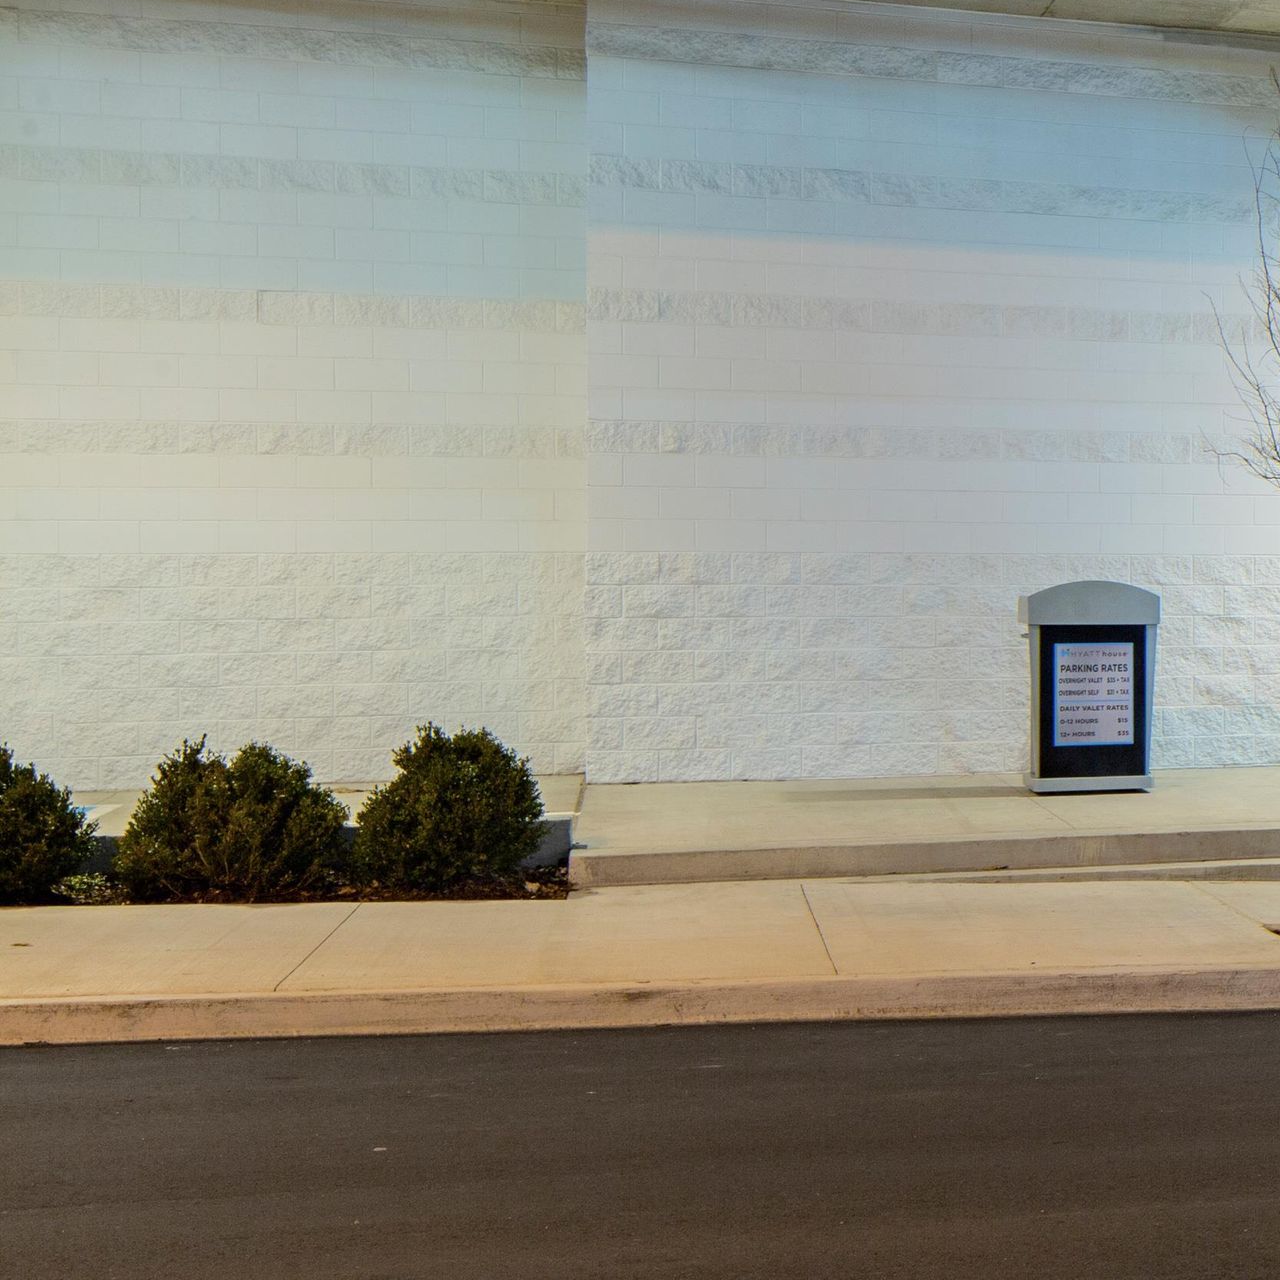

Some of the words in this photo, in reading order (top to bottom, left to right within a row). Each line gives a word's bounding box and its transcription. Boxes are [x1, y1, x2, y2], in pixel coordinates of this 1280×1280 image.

[1102, 649, 1128, 657] house
[1060, 664, 1099, 672] PARKING
[1101, 664, 1128, 672] RATES
